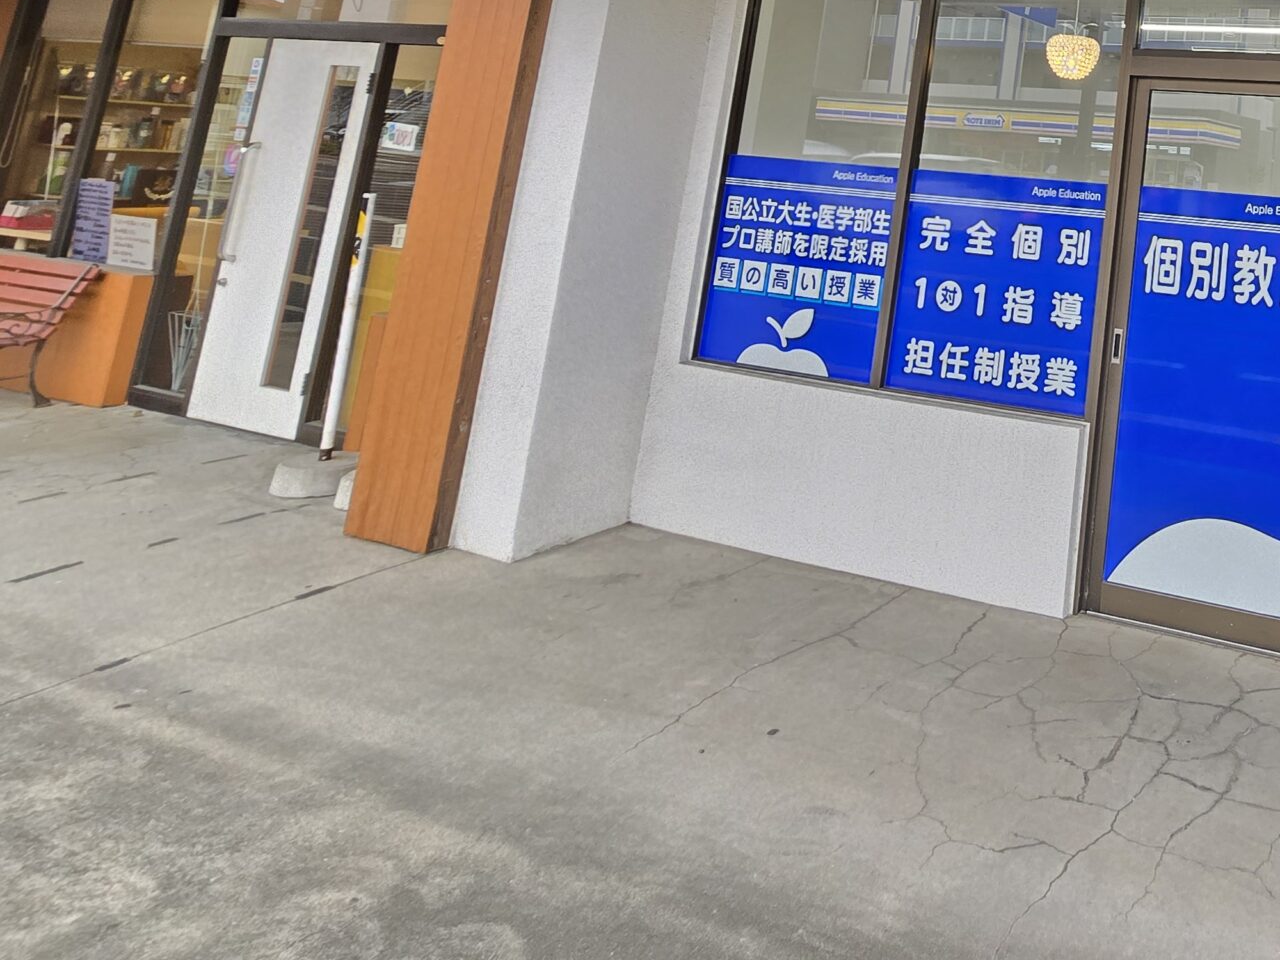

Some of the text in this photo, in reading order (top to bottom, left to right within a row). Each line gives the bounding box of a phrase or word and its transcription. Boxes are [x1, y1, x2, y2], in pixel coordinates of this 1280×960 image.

[832, 170, 894, 184] Apple Education
[1032, 186, 1101, 201] Apple Education
[725, 195, 891, 236] 国公立大生・医学部生
[1245, 203, 1273, 216] Apple
[722, 224, 888, 267] プロ講師を限定採用
[919, 216, 1091, 266] 完全個別
[717, 260, 877, 301] 質の高い授業
[903, 337, 1078, 397] 担任制授業
